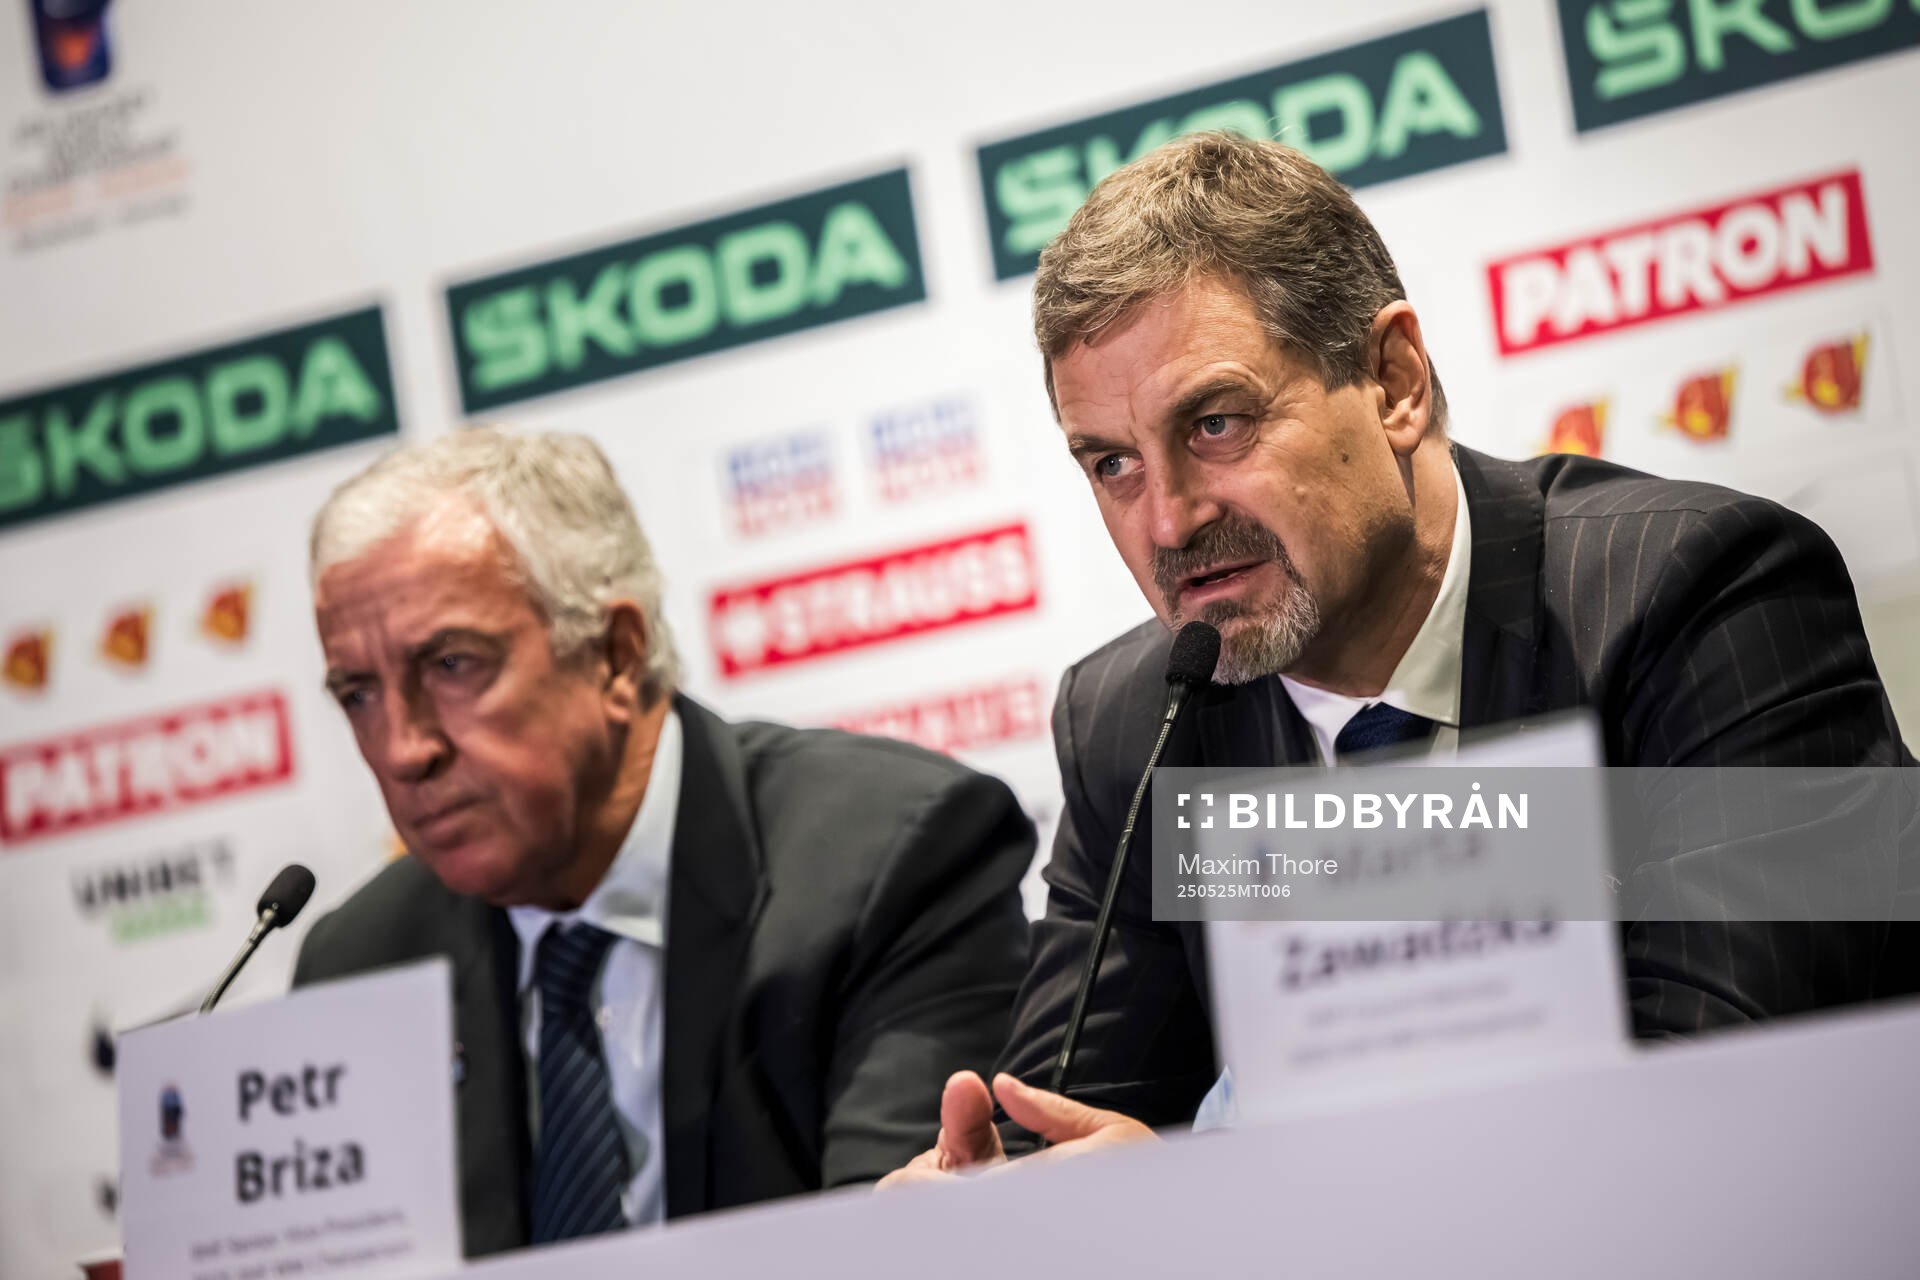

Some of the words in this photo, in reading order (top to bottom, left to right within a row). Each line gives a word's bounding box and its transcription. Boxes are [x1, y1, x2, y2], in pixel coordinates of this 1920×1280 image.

[1502, 180, 1850, 344] PATRON
[4, 706, 275, 834] PATRON
[237, 1061, 346, 1124] Petr
[235, 1139, 366, 1206] Briza
